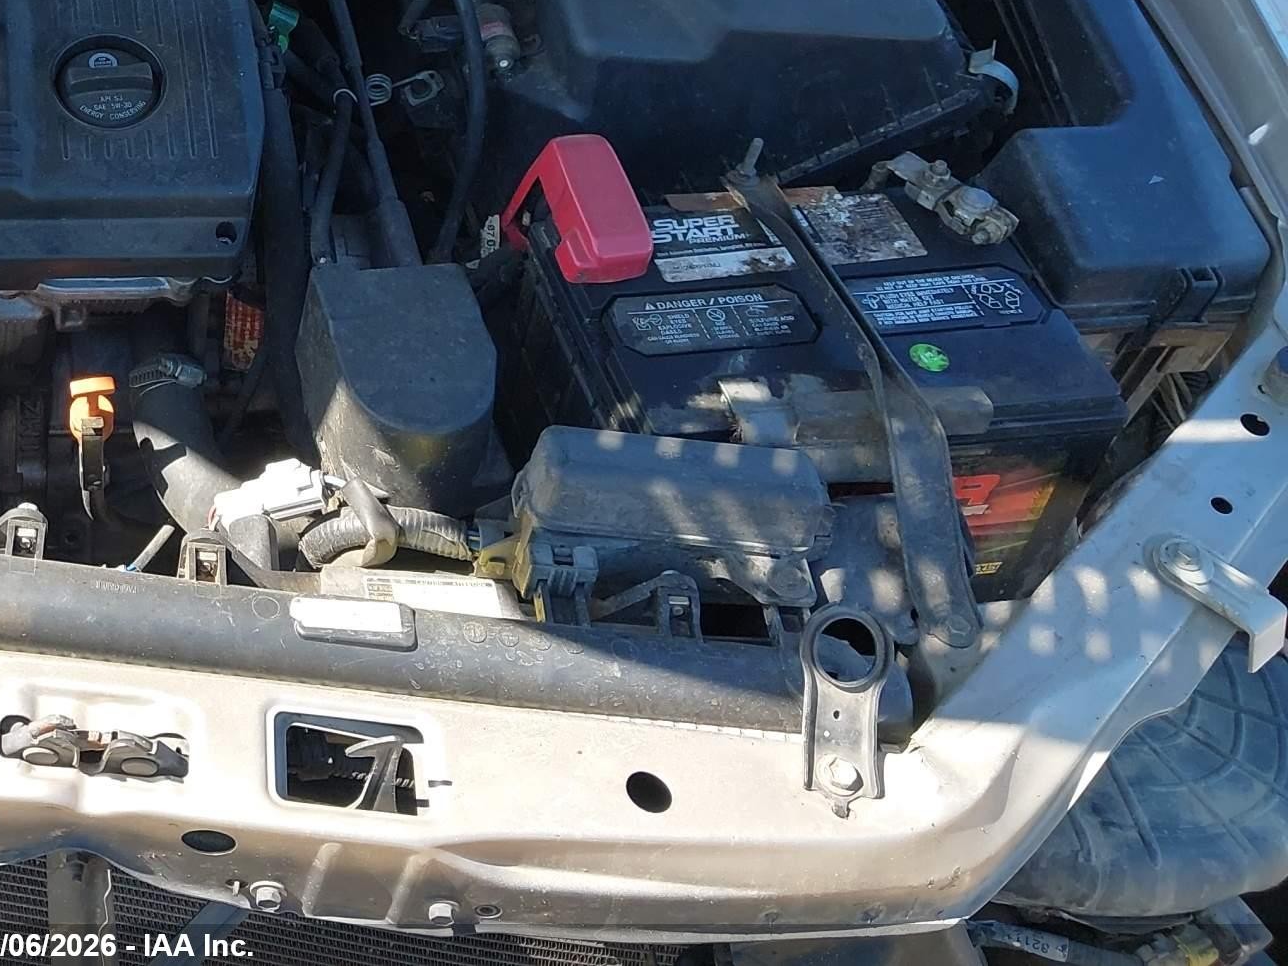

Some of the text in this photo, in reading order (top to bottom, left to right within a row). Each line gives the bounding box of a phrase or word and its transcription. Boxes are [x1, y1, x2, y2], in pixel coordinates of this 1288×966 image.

[653, 214, 736, 232] SUPER
[651, 224, 740, 243] START
[655, 293, 764, 310] DANGER / POISON
